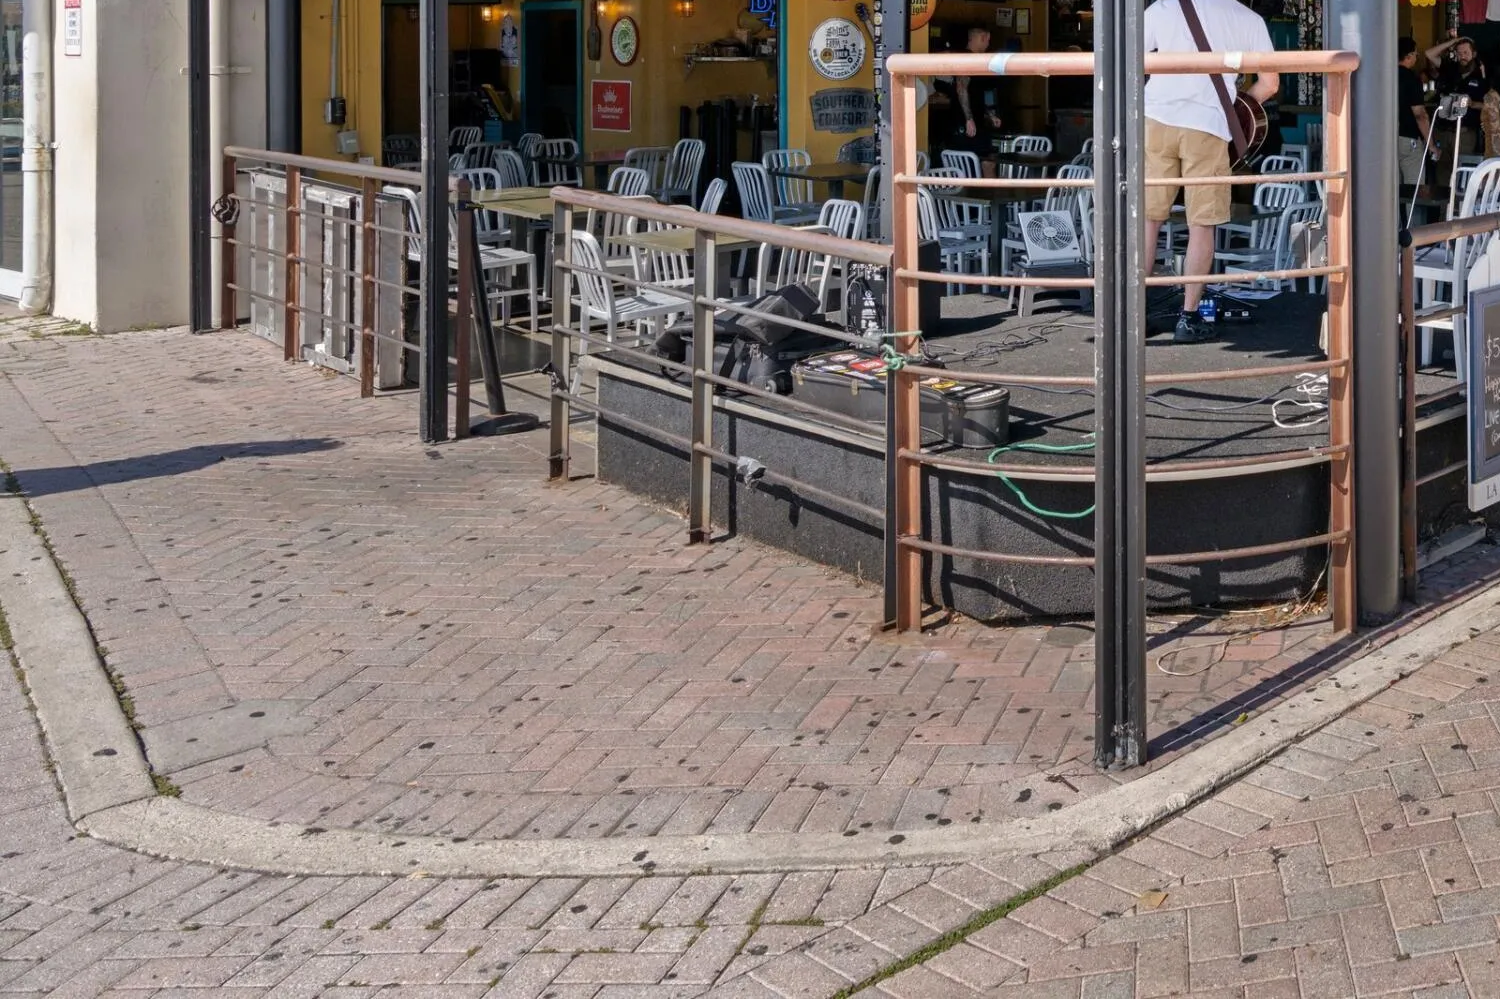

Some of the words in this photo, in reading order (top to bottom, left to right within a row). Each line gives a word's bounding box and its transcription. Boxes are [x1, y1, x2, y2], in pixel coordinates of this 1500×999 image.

[818, 112, 868, 126] COMFORT
[1485, 334, 1500, 364] $5
[1484, 409, 1500, 429] LIVE
[1486, 485, 1499, 500] LA
